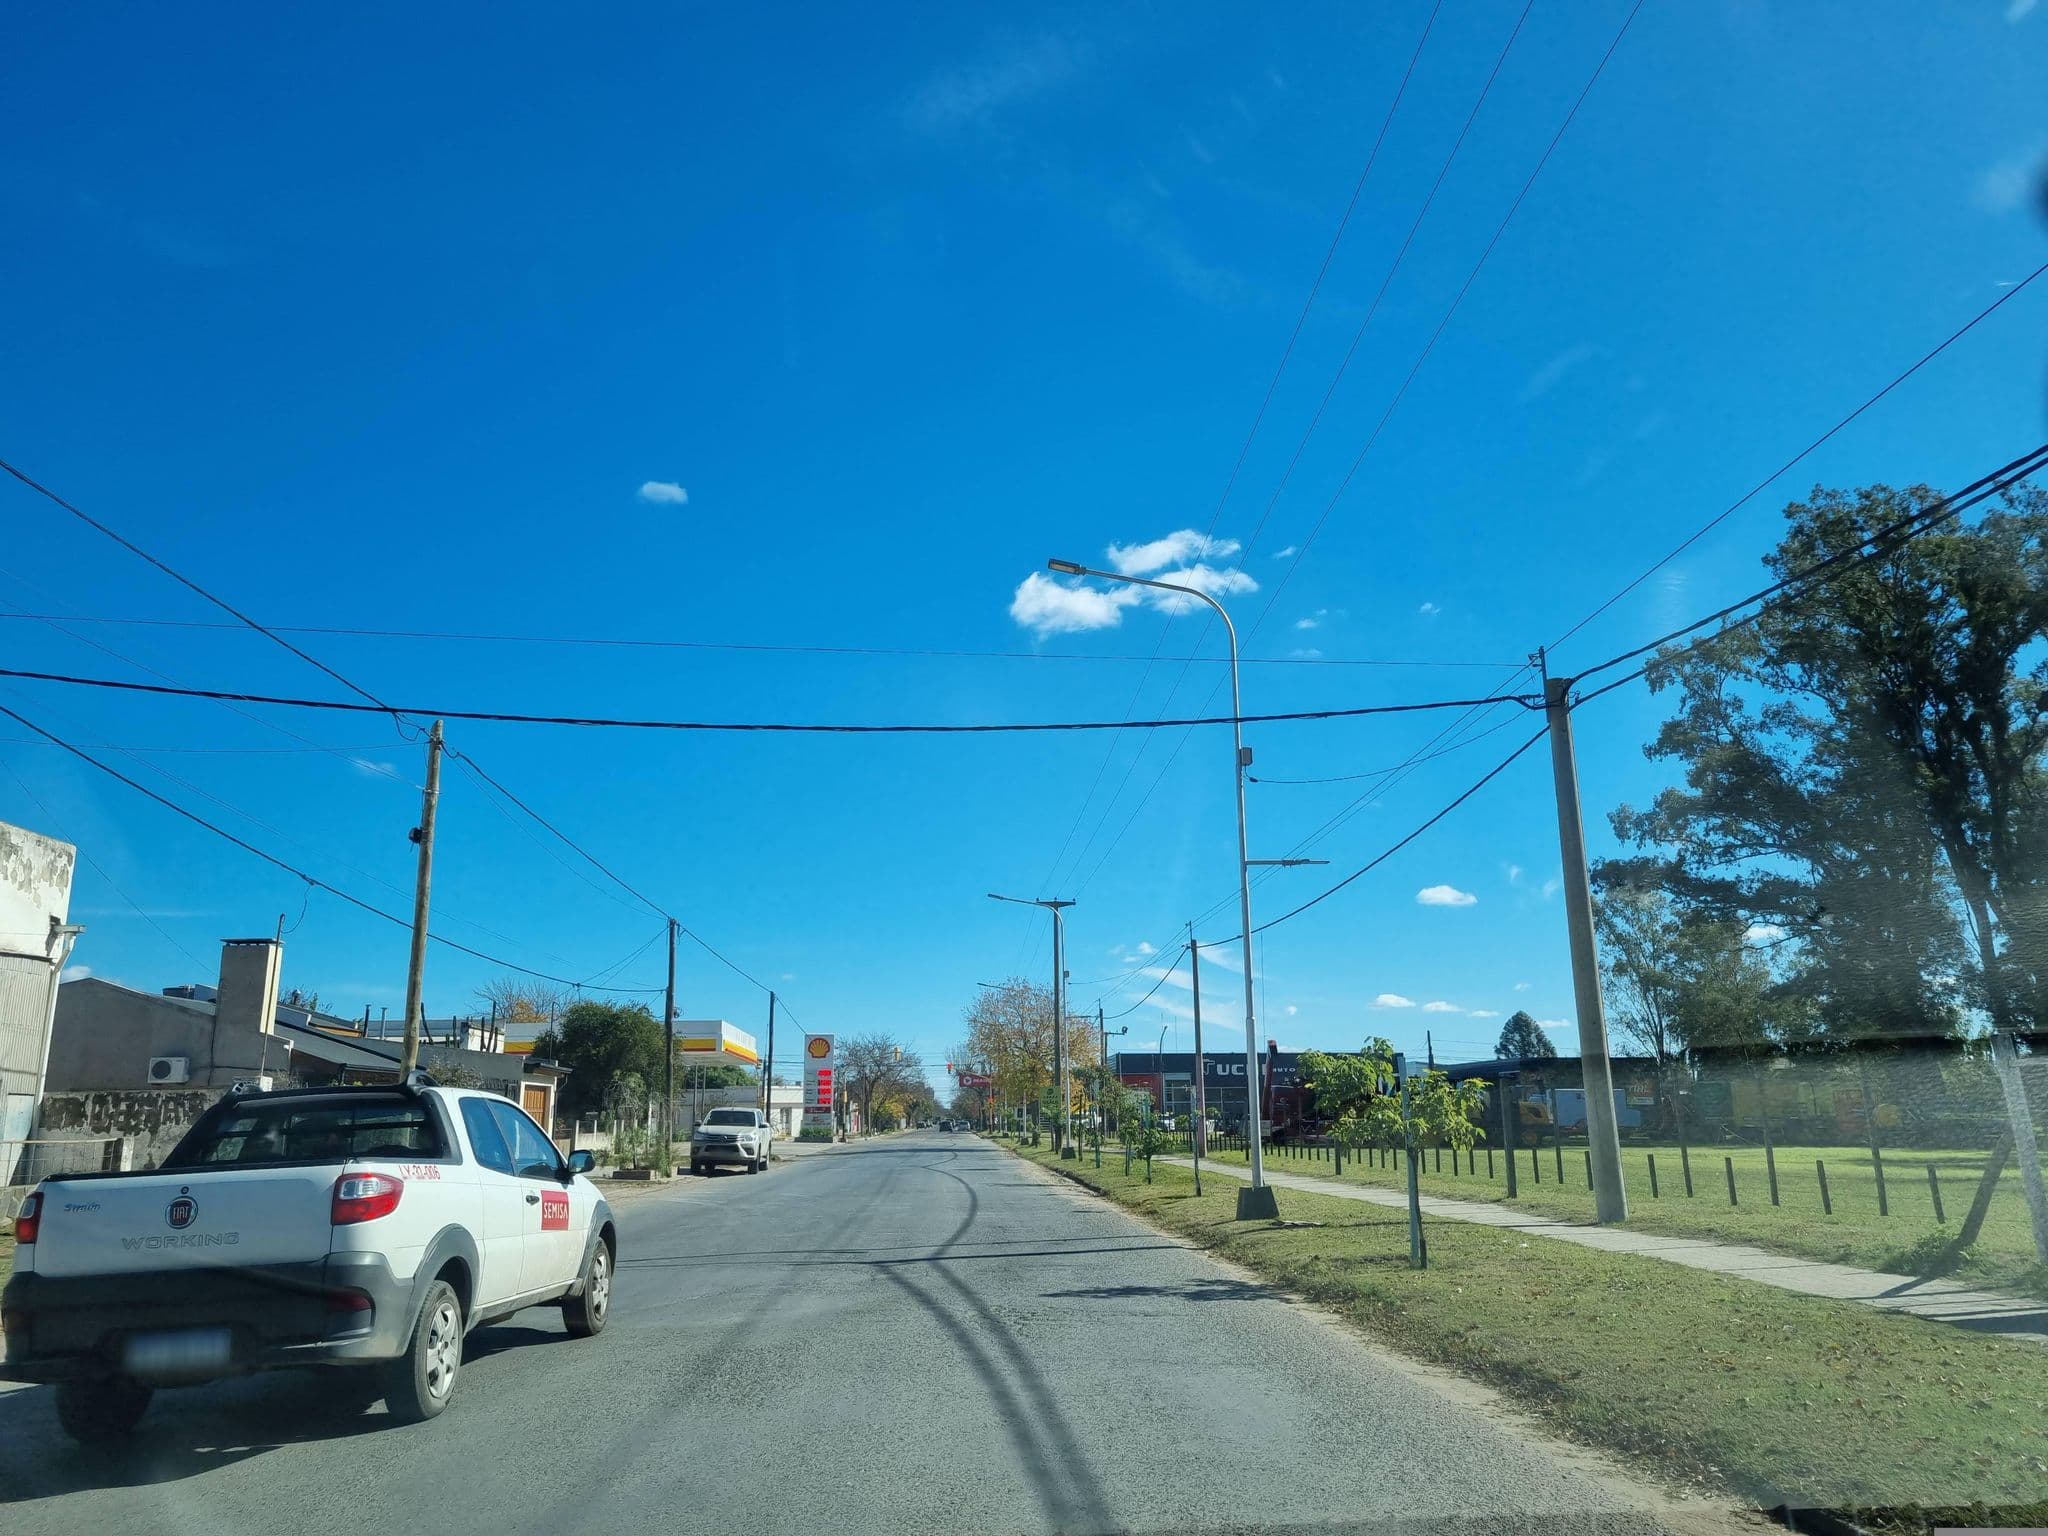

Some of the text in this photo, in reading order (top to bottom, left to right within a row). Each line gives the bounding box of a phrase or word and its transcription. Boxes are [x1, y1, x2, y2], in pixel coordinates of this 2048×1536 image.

[173, 1205, 190, 1220] FIAT
[544, 1202, 568, 1219] SEMISA
[121, 1232, 240, 1251] WORKING
